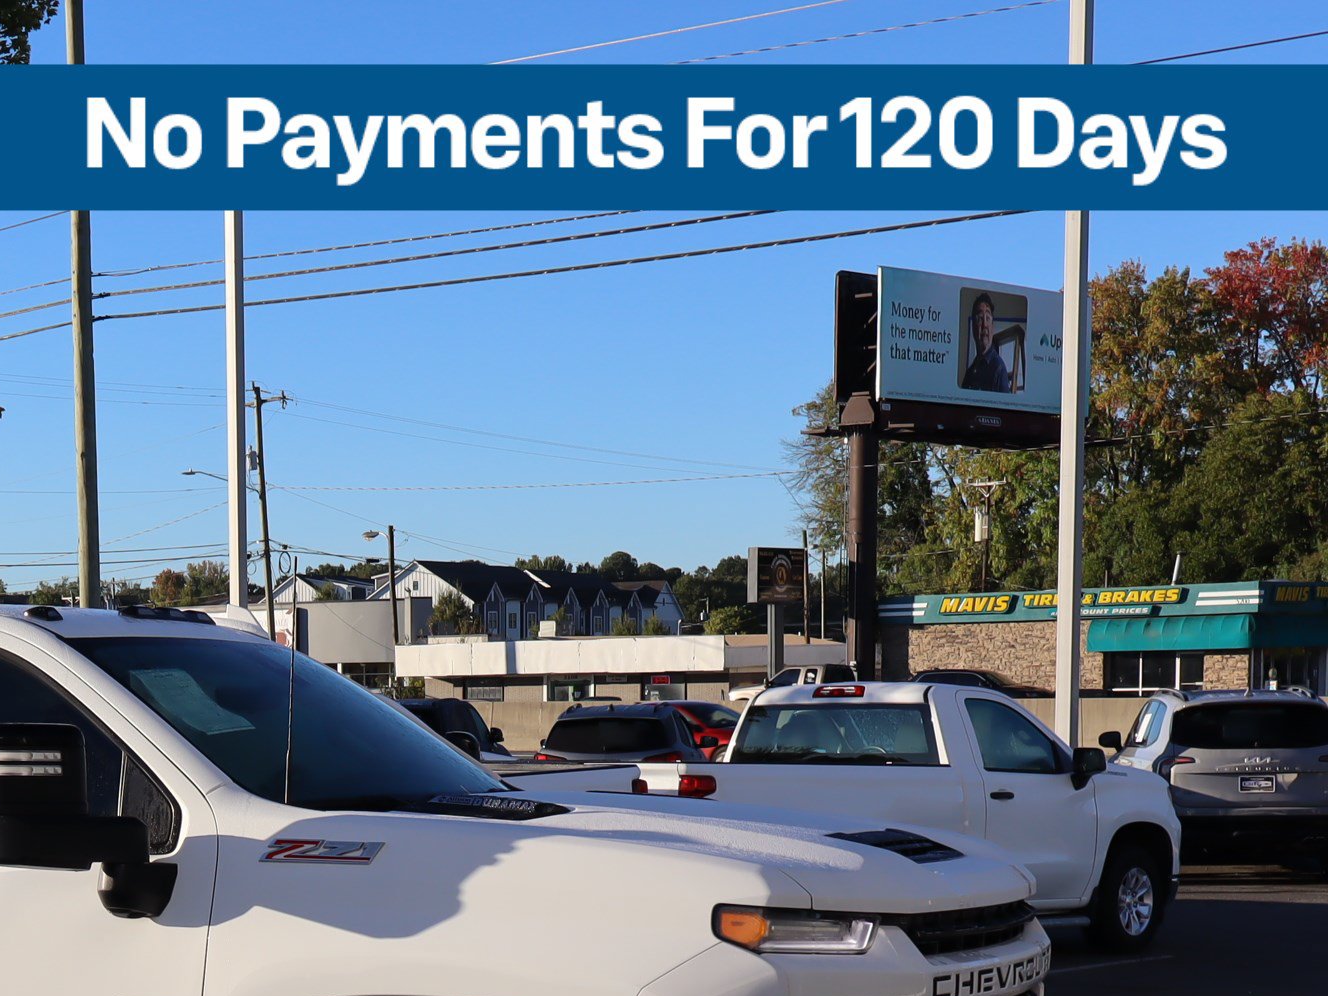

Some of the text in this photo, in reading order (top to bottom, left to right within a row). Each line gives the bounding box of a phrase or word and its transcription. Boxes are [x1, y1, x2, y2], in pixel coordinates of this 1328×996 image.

[891, 301, 941, 323] Money for
[891, 323, 952, 344] the moments
[890, 344, 911, 361] that
[940, 588, 1180, 613] MAVIS TIR & BRAKES
[1276, 586, 1310, 601] MAVIS
[258, 839, 386, 865] Z71
